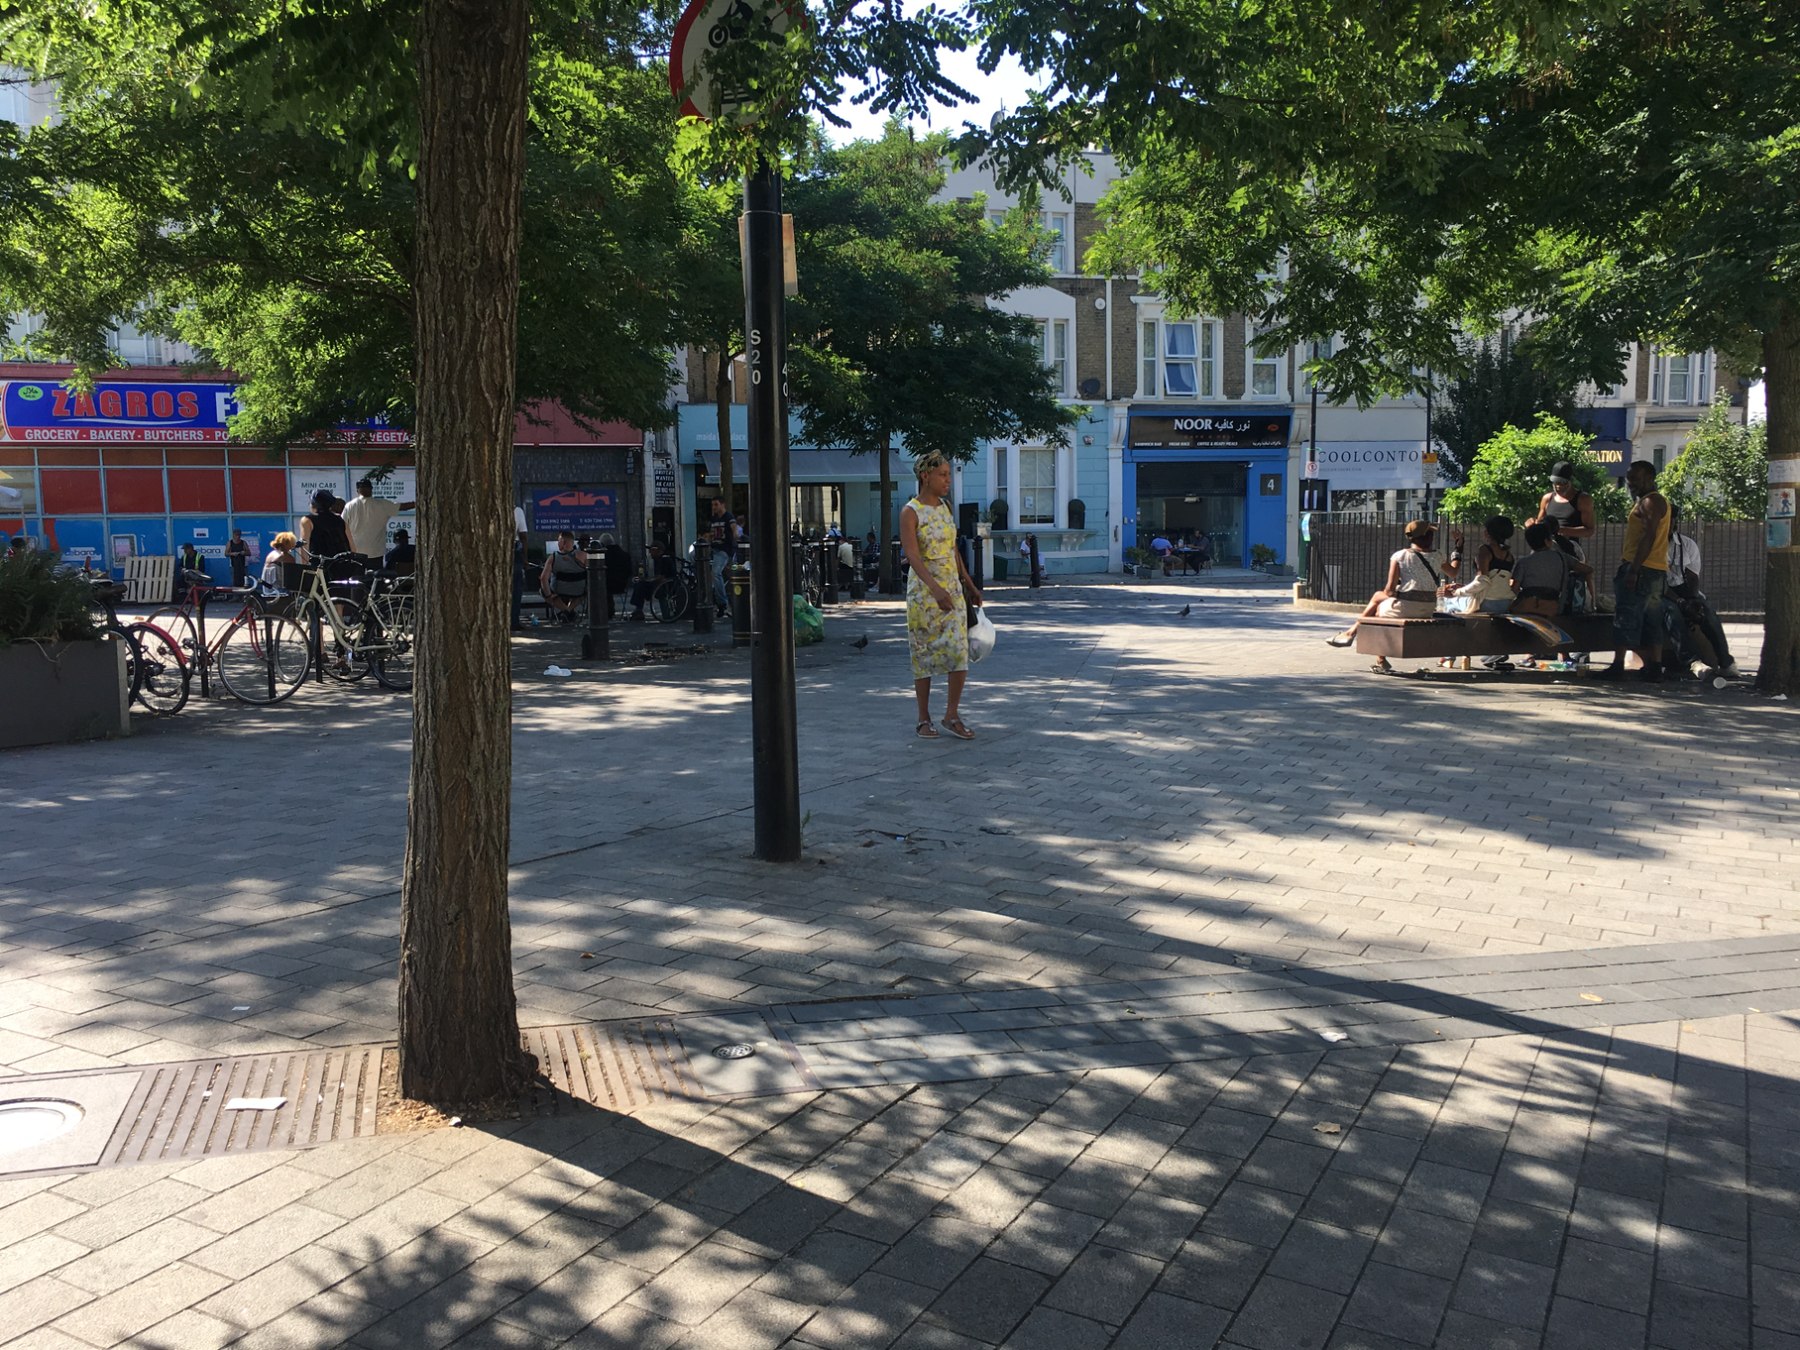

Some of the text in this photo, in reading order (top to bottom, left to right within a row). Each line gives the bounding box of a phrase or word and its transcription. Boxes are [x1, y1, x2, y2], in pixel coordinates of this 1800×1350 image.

[51, 389, 199, 418] ZAGROS
[1173, 418, 1212, 430] NOOR
[1236, 420, 1251, 432] نور
[25, 429, 79, 440] GROCERY
[90, 430, 135, 440] BAKERY
[144, 430, 203, 441] BUTCHERS
[1318, 450, 1422, 464] COOLCONTO
[1267, 478, 1275, 491] 4
[388, 521, 412, 530] CABS
